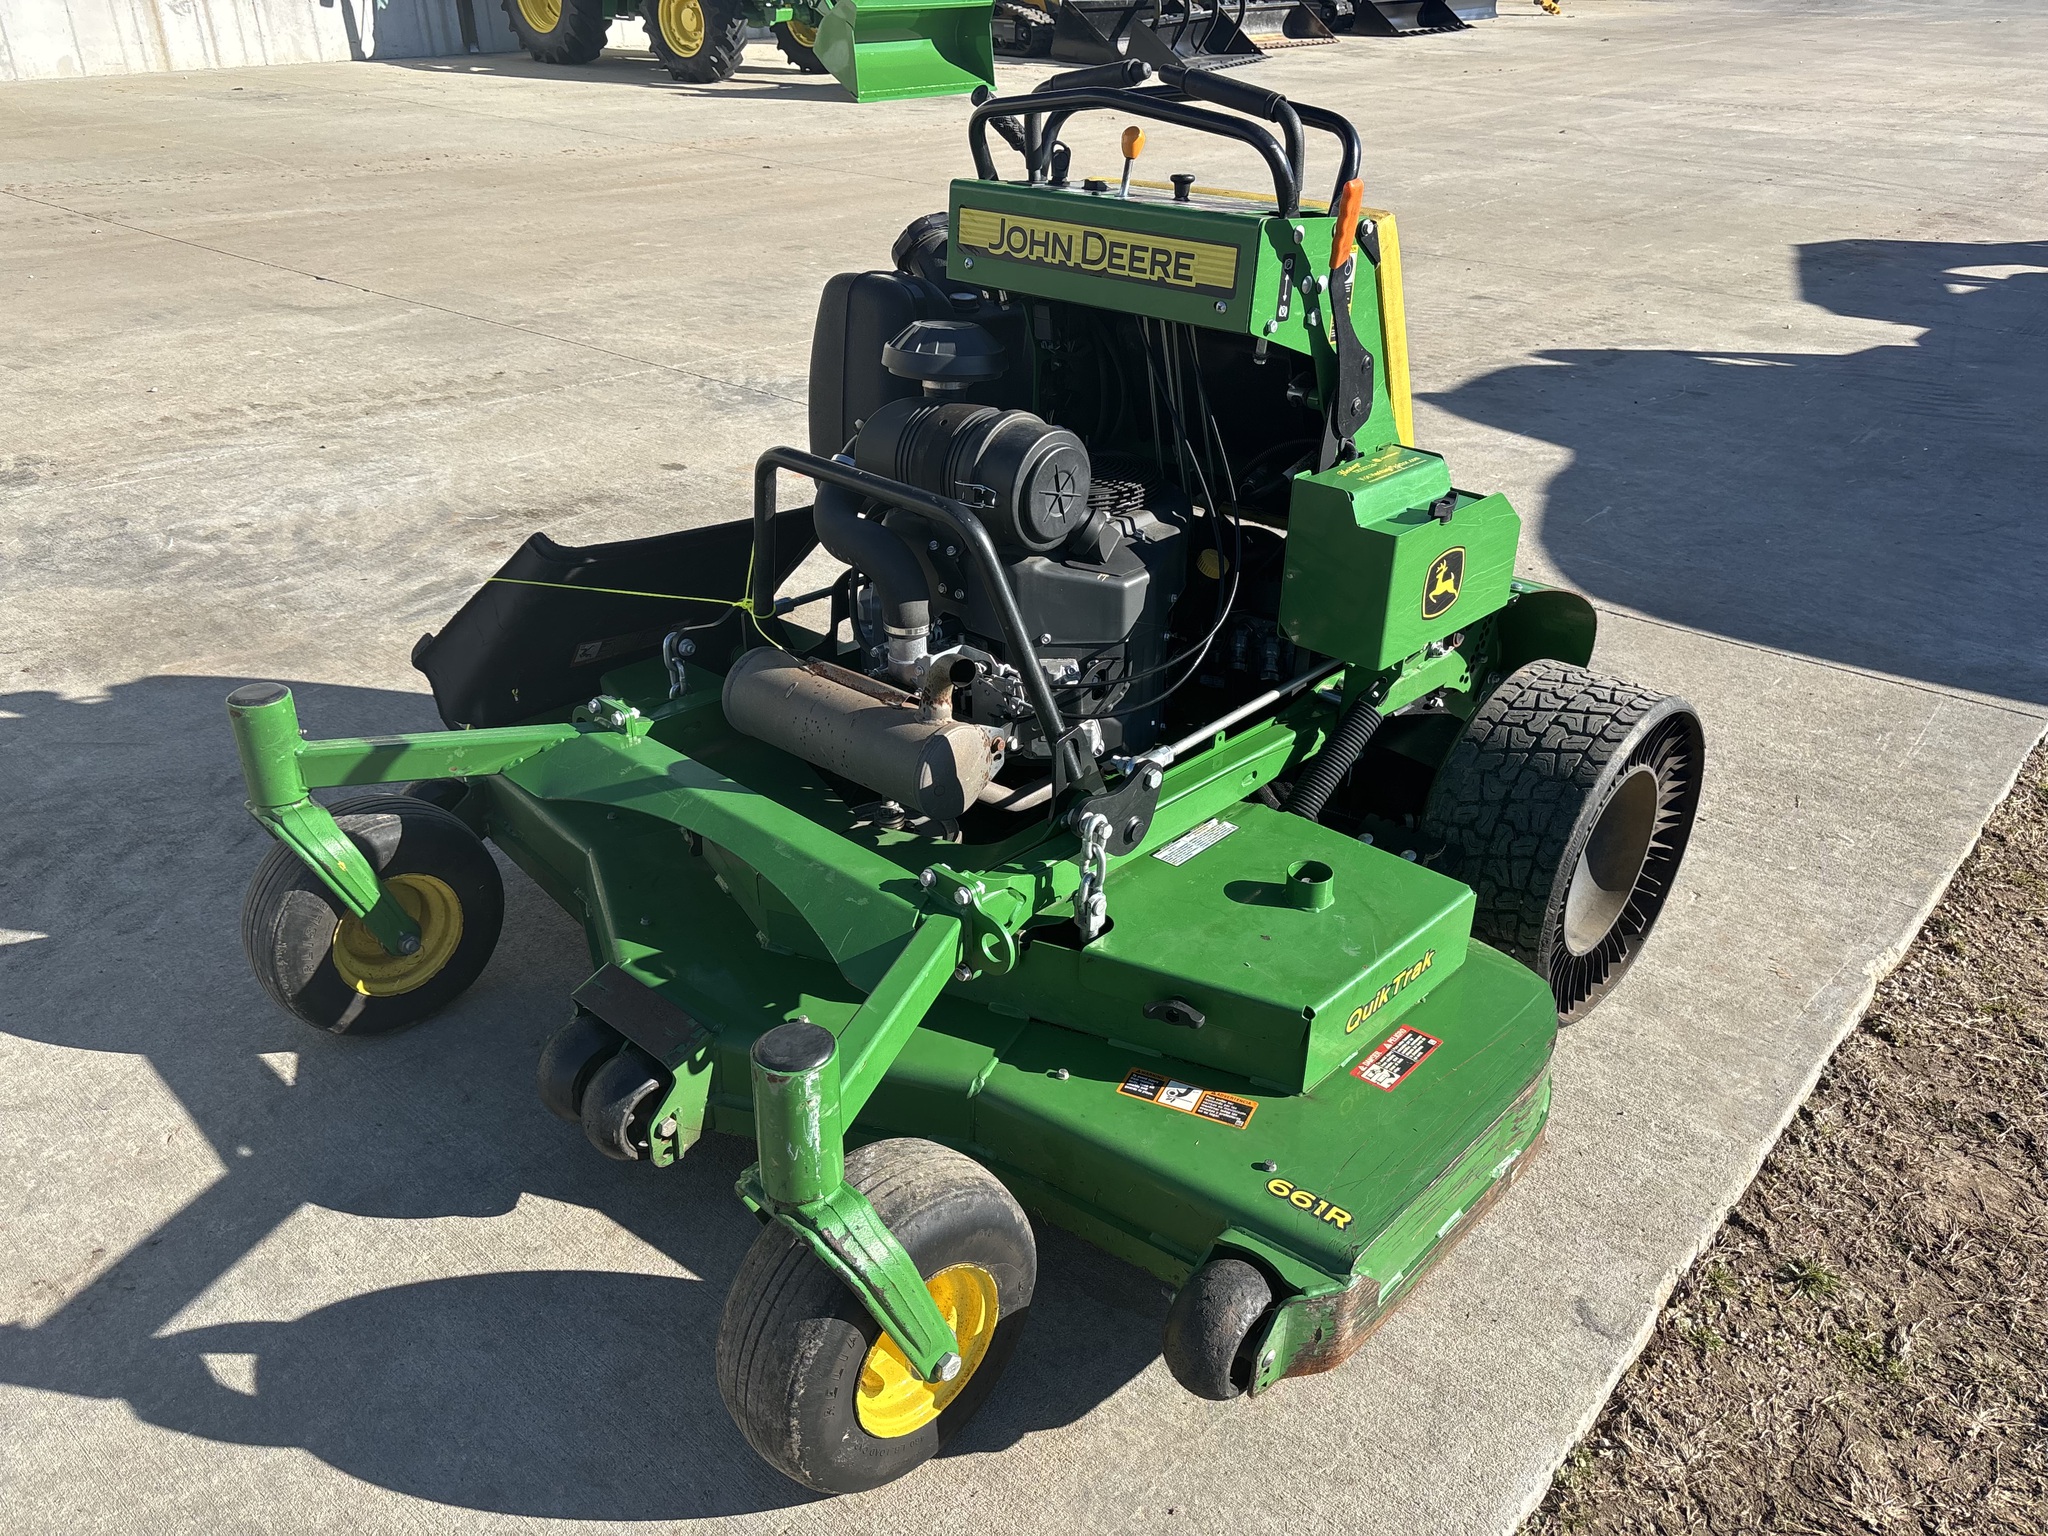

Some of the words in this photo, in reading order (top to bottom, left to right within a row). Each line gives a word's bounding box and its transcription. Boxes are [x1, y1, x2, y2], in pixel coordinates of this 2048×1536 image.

[989, 218, 1073, 262] JOHN
[1081, 230, 1196, 283] DEERE
[1345, 985, 1392, 1034] Quik
[1393, 949, 1436, 995] Trak
[1266, 1177, 1354, 1231] 661R
